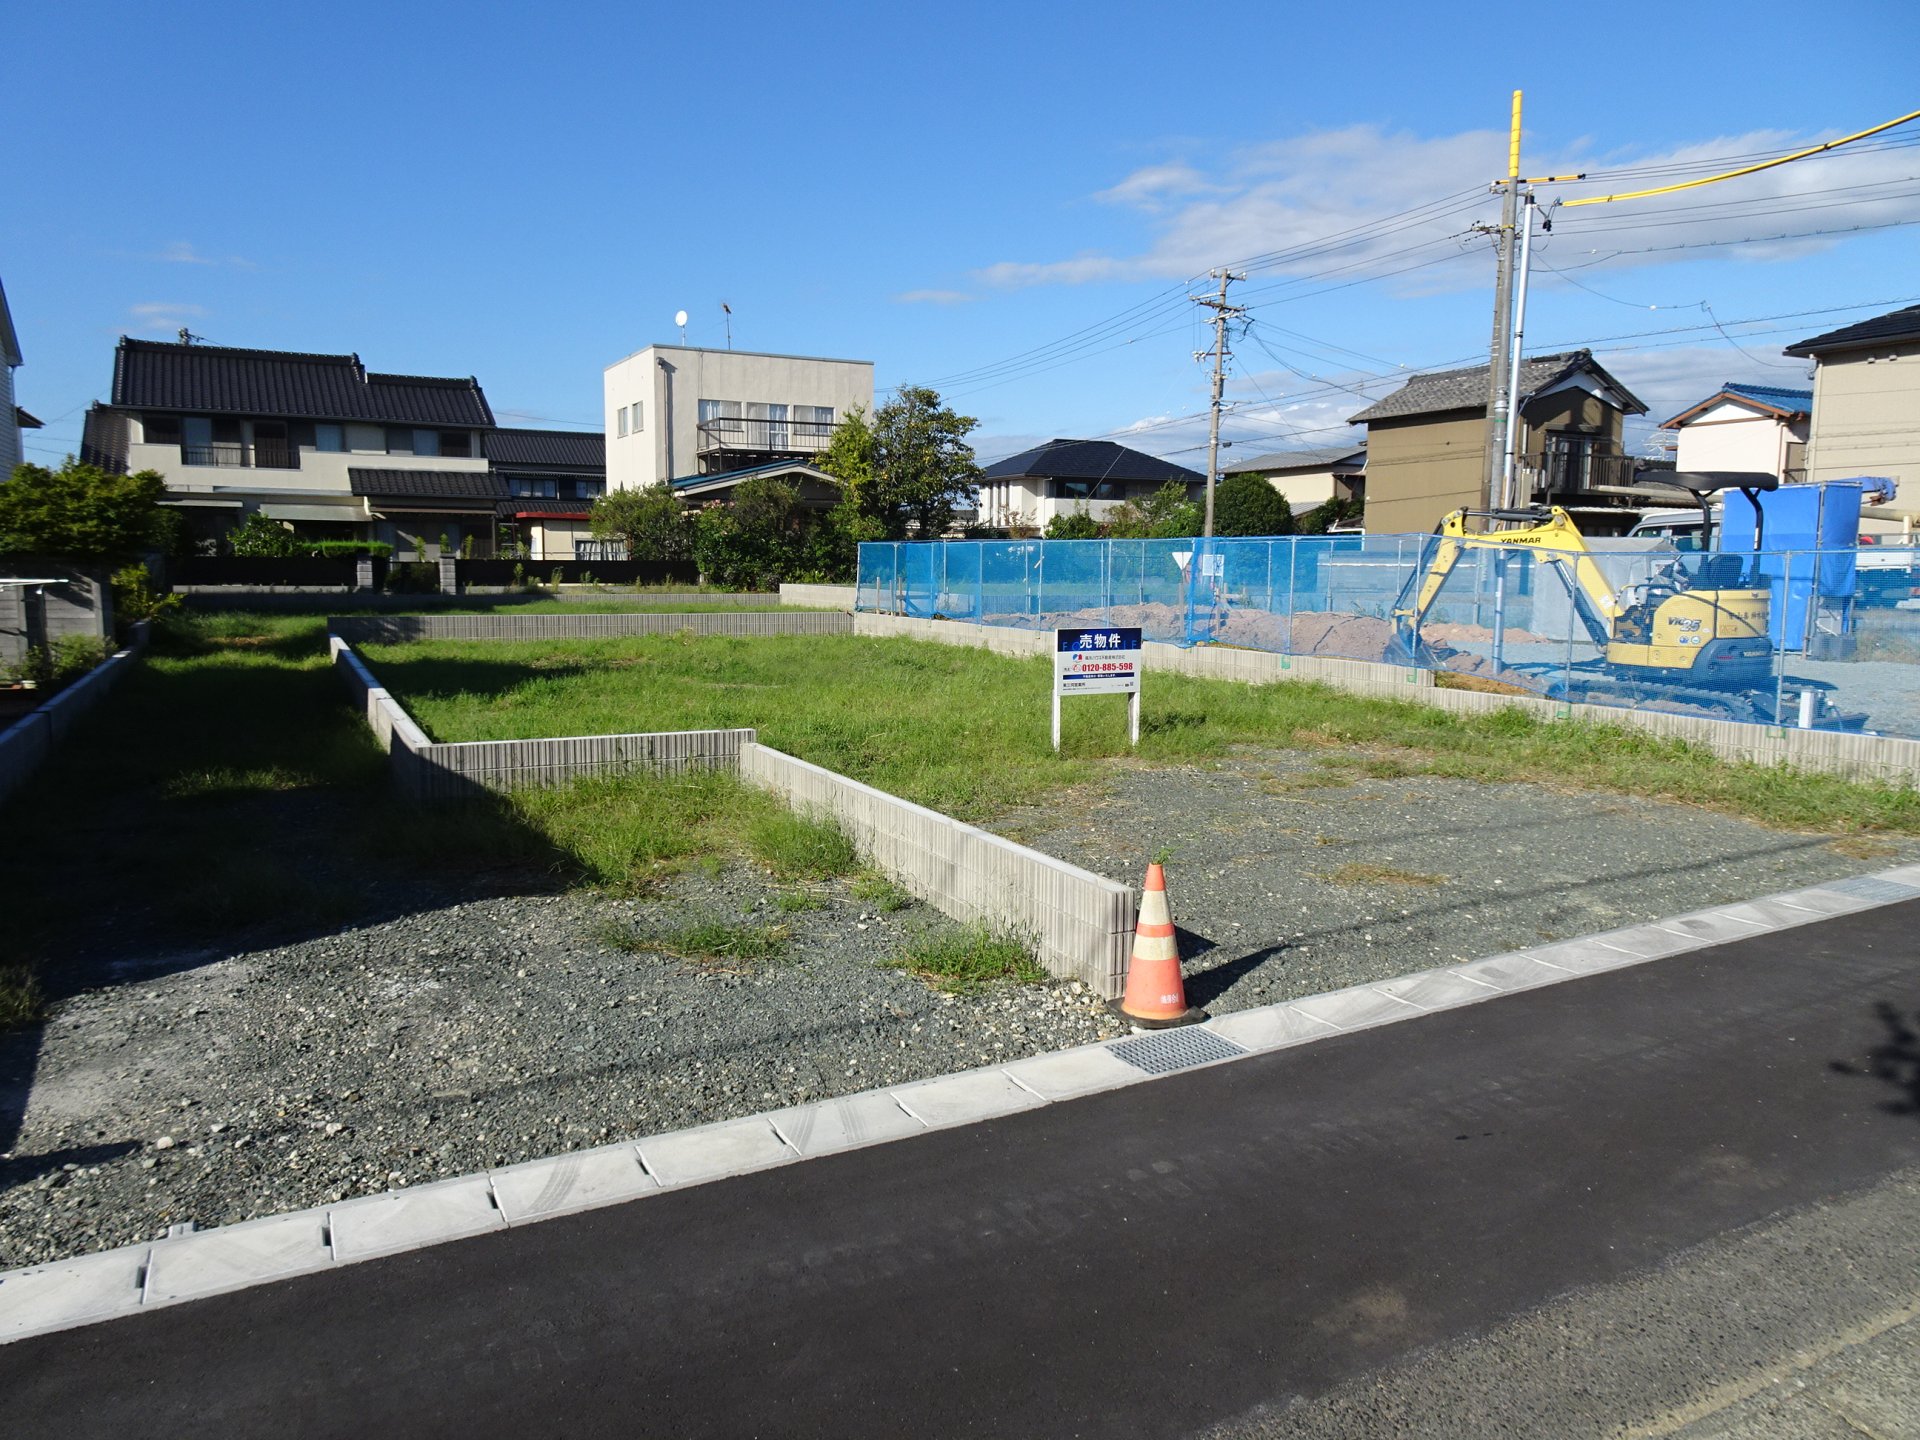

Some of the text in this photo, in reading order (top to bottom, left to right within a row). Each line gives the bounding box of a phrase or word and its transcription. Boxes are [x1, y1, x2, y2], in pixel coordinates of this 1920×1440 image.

[1079, 633, 1122, 649] 売物件
[1082, 662, 1133, 672] 0120-885-598
